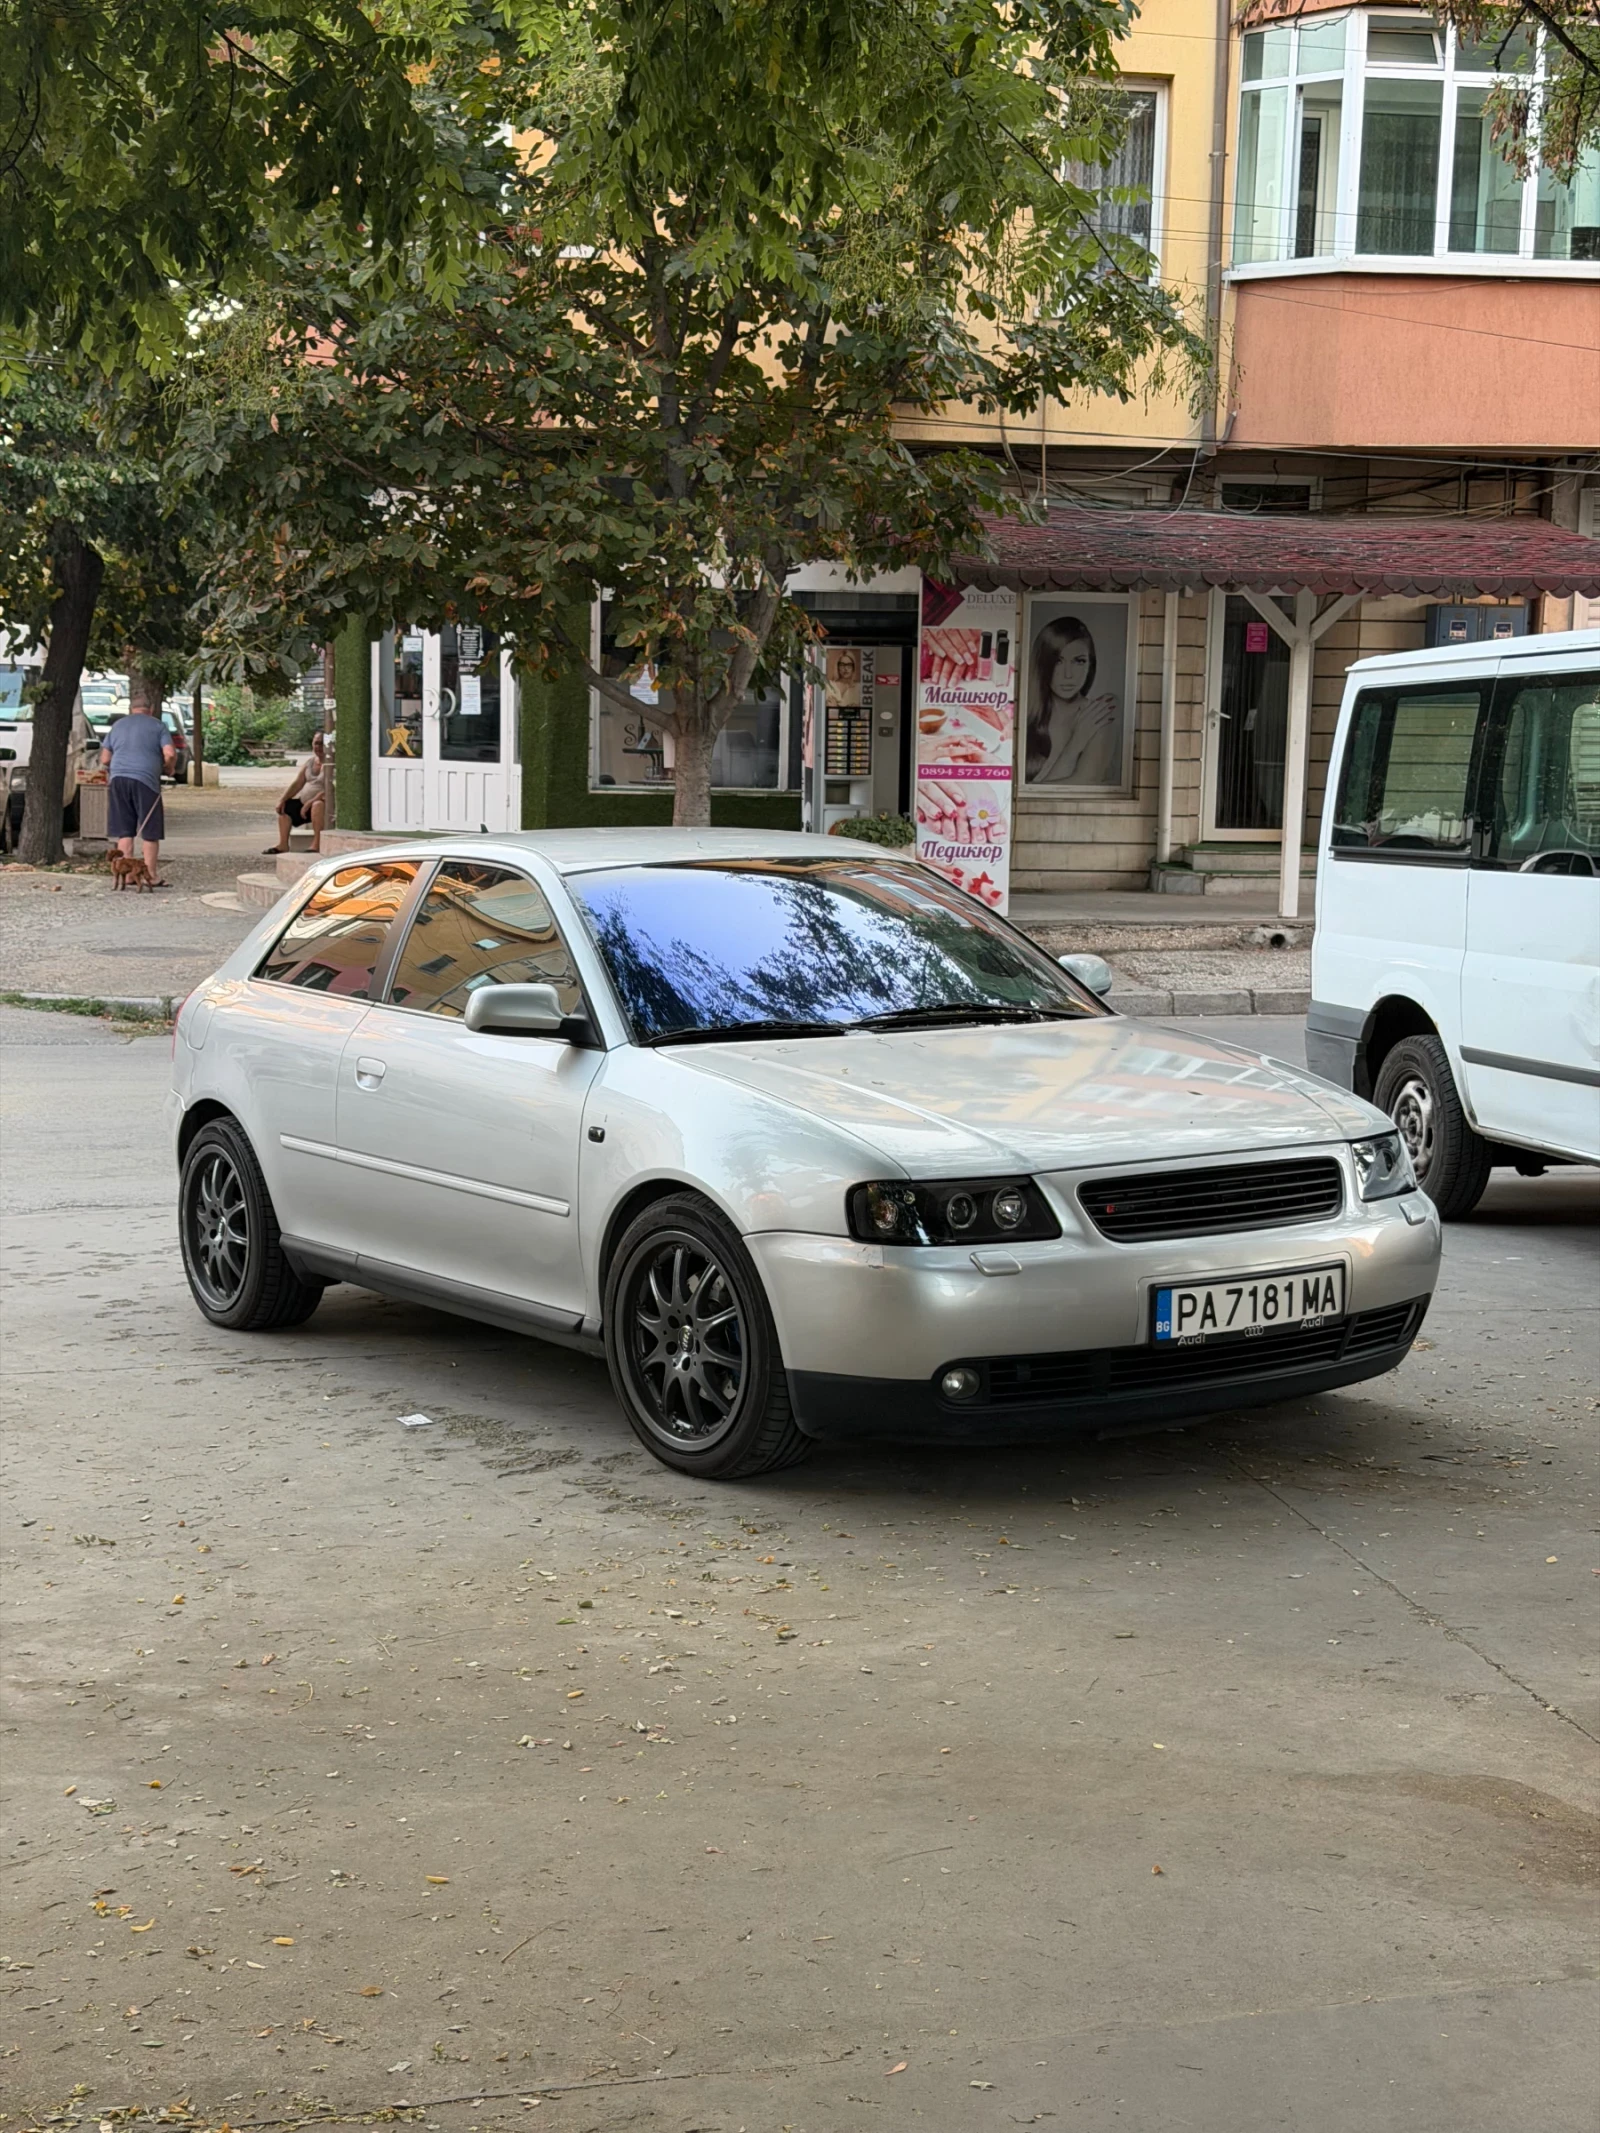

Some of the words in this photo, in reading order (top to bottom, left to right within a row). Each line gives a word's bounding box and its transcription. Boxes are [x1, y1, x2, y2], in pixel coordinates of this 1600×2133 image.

[967, 594, 1016, 604] DELUXE
[862, 650, 874, 705] BREAK
[924, 686, 1008, 709] Маникюр
[921, 768, 953, 776] 0894
[957, 768, 981, 777] 573
[985, 769, 1010, 777] 760
[921, 840, 1002, 864] Педикюр
[1156, 1321, 1170, 1333] BG
[1300, 1315, 1325, 1330] Audi
[1177, 1332, 1206, 1346] Audi
